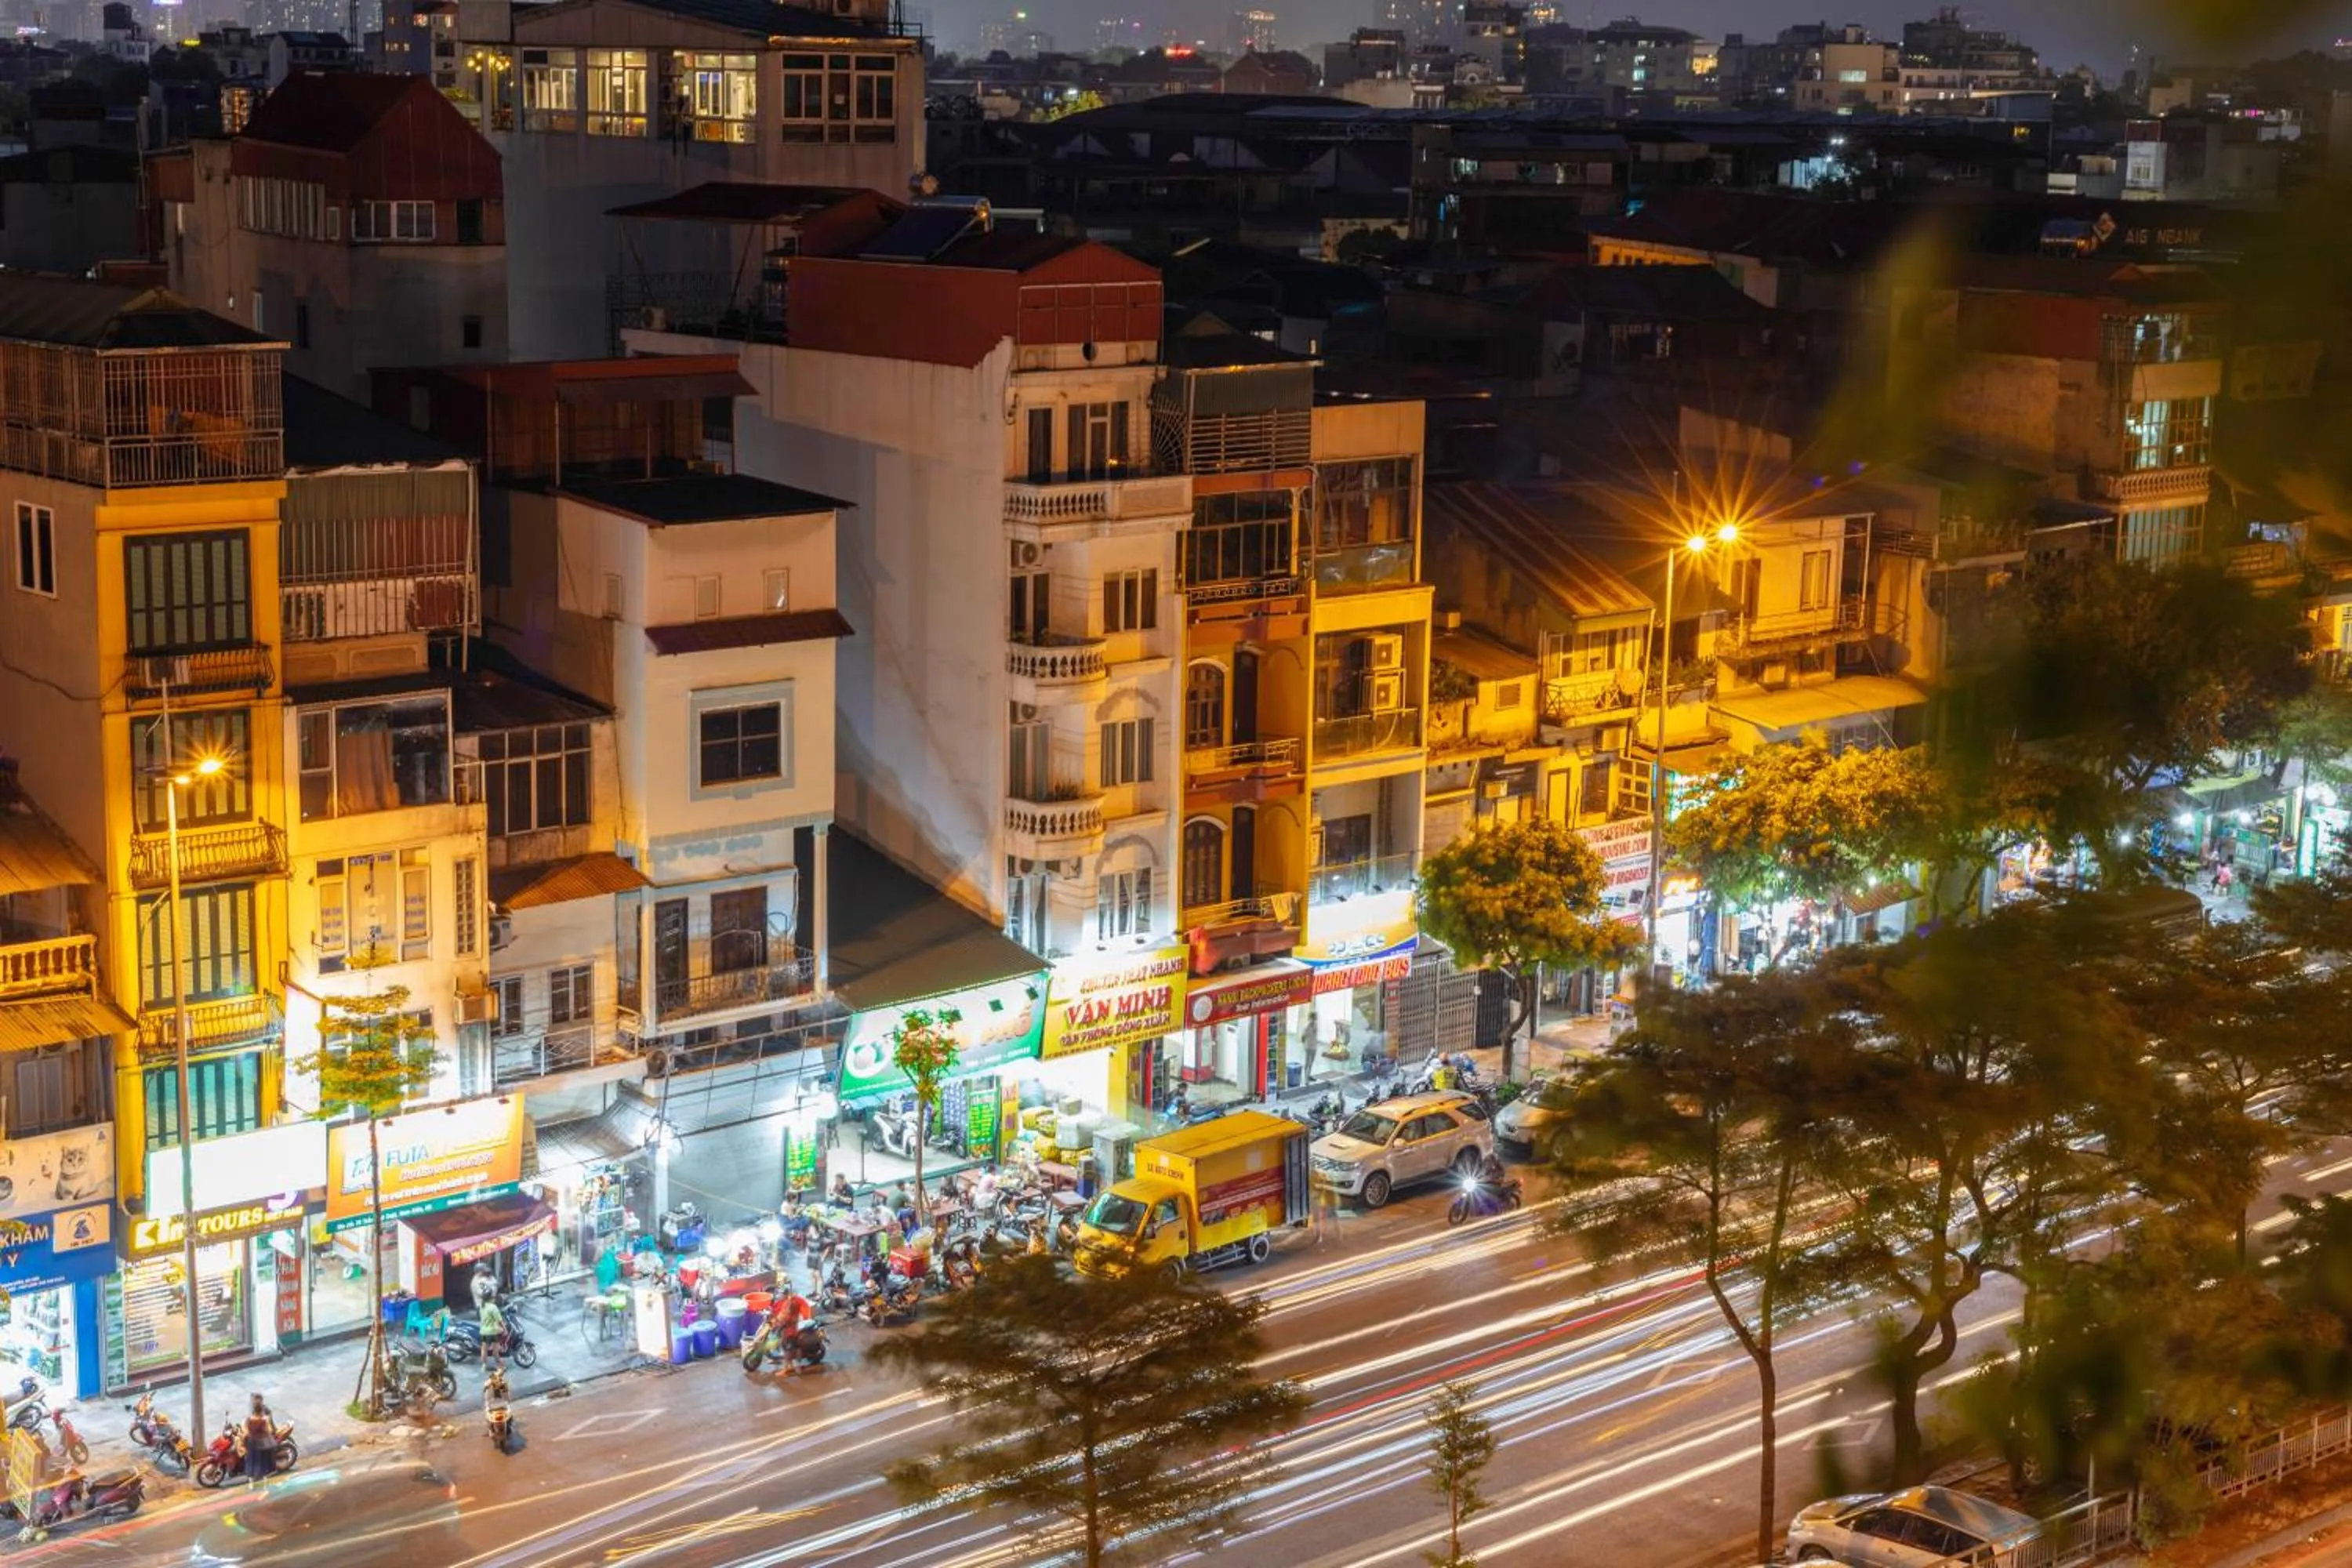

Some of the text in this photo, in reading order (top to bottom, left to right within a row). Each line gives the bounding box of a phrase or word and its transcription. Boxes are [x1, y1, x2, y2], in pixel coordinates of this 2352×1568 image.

[1149, 956, 1185, 977] NHANH
[1384, 955, 1410, 980] BUS
[1067, 985, 1173, 1027] VĂN MINH
[198, 1207, 263, 1236] TOURS
